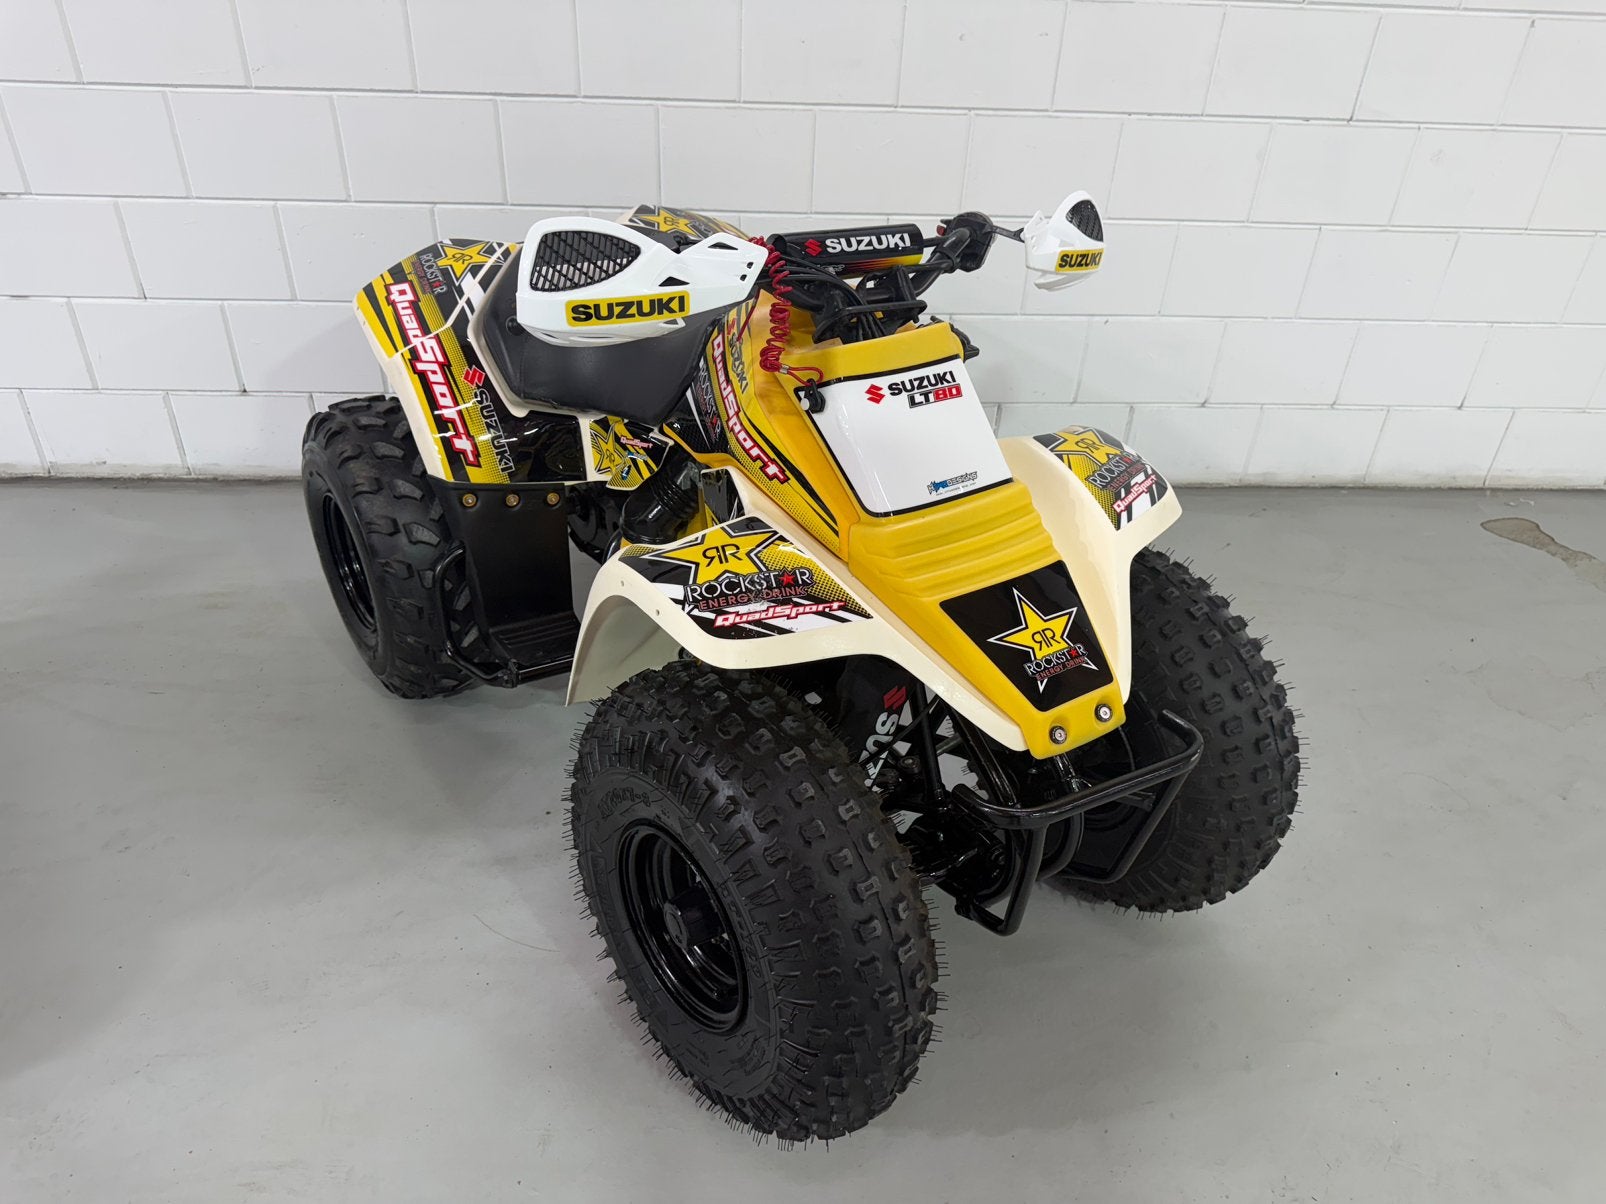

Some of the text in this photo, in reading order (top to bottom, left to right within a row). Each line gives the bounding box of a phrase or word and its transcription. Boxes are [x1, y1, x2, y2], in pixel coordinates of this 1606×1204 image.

[825, 233, 911, 253] SUZUKI
[1058, 252, 1102, 268] SUZUKI
[571, 295, 685, 322] SUZUKI
[386, 282, 480, 467] QuadSport
[888, 371, 956, 396] SUZUKI
[697, 331, 790, 484] QuadSport
[908, 384, 962, 408] LT80
[474, 388, 516, 473] SUZUKI
[1112, 474, 1157, 514] QuadSport
[700, 585, 807, 611] ENERGY DRINK
[714, 600, 847, 628] QuadSport
[1036, 656, 1085, 680] ENERGY DRINK
